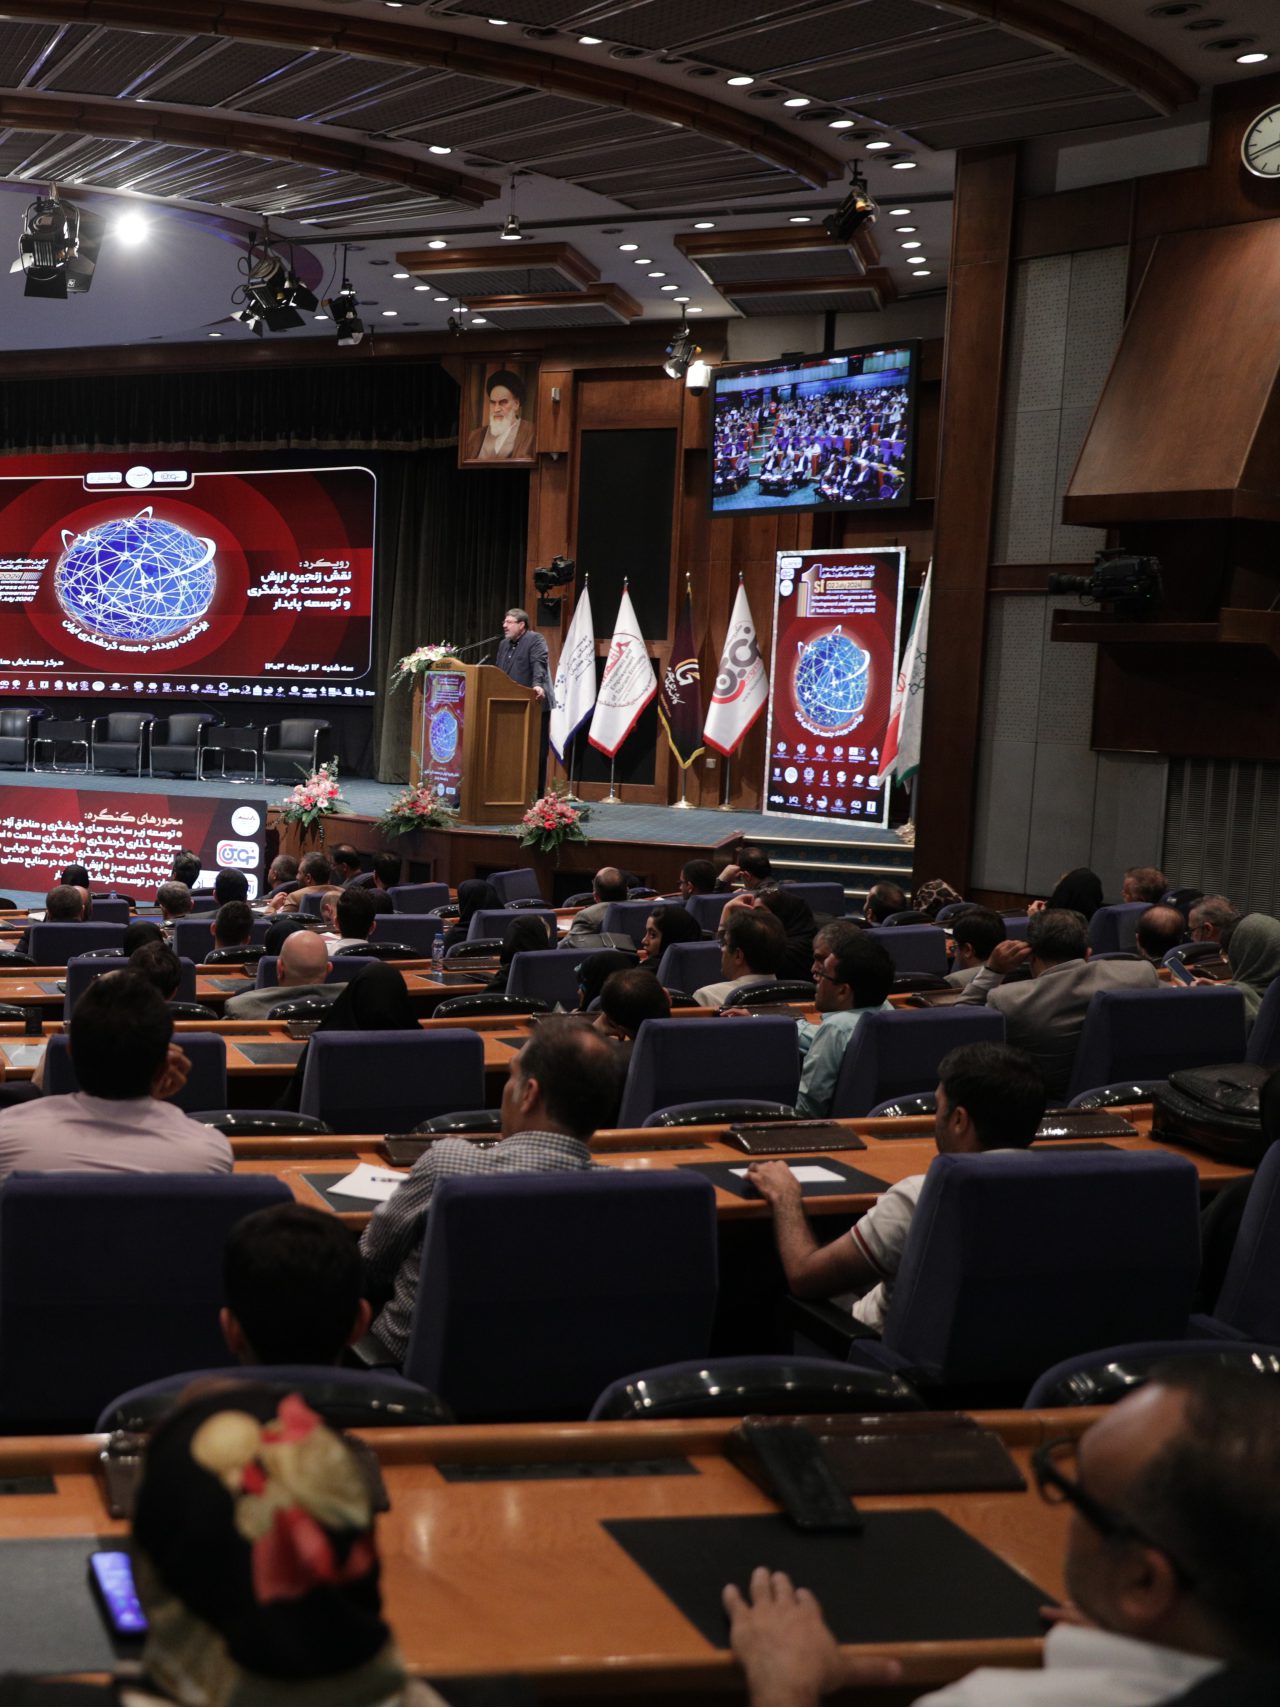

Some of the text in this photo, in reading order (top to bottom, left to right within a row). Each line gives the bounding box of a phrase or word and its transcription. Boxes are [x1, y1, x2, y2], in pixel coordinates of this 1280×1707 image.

[260, 570, 352, 583] نقش زنجیره ارزش
[247, 583, 351, 597] در صنعت گردشگری
[272, 598, 351, 612] و توسعه پایدار
[12, 658, 44, 667] همایش
[44, 659, 64, 667] مرکز
[84, 808, 183, 828] محورهای کنگره:
[14, 819, 40, 830] مناطق
[41, 823, 46, 831] و
[47, 820, 84, 832] گردشگری
[85, 824, 104, 834] های
[13, 831, 41, 841] سلامت
[105, 826, 133, 835] ساخت
[133, 829, 146, 838] زیر
[147, 829, 176, 840] توسعه
[41, 832, 79, 845] گردشگری
[87, 835, 125, 848] گردشگری
[126, 839, 151, 849] گذاری
[2, 843, 30, 853] دریایی
[31, 844, 69, 856] گردشگری
[152, 841, 182, 851] سرمایه
[75, 847, 114, 860] گردشگری
[116, 850, 148, 861] خدمات
[0, 854, 24, 865] دستی
[24, 856, 48, 868] صنایع
[48, 859, 57, 868] در
[85, 859, 103, 871] ارزش
[110, 862, 126, 872] سبز
[126, 863, 151, 875] گذاری
[151, 866, 173, 877] رمایه
[88, 871, 115, 884] گردشگ
[116, 877, 145, 888] توسعه
[145, 879, 155, 888] در
